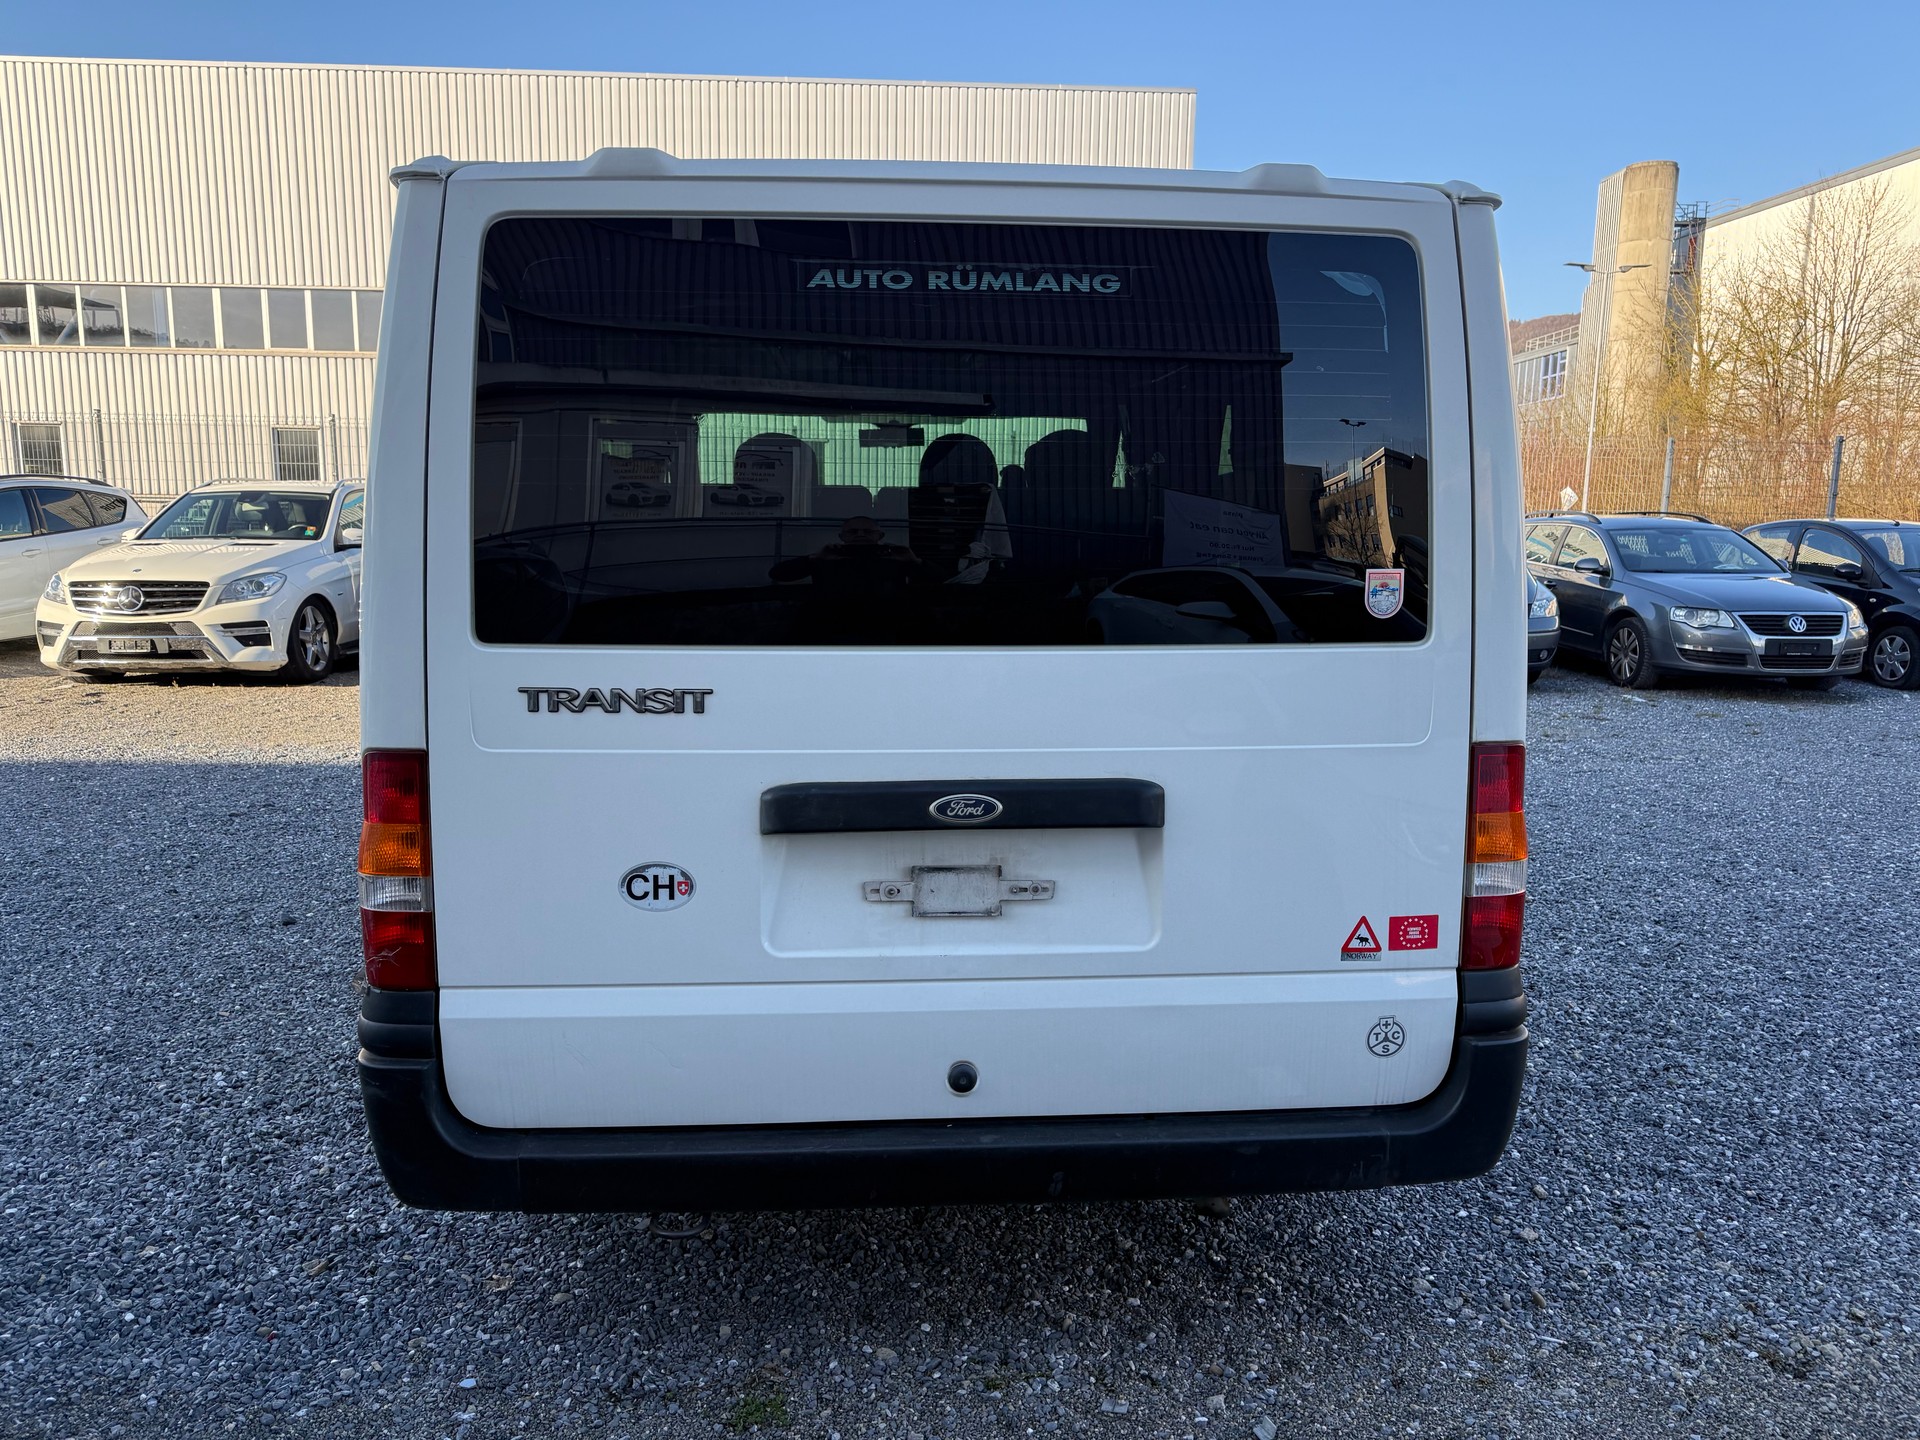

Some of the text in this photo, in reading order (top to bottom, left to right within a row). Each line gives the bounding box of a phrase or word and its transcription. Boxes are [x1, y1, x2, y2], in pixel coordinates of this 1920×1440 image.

[806, 264, 1121, 293] AUTO RÜMLANG
[518, 687, 713, 714] TRANSIT
[947, 800, 984, 816] Ford
[626, 873, 675, 901] CH
[1345, 952, 1378, 960] NORWAY
